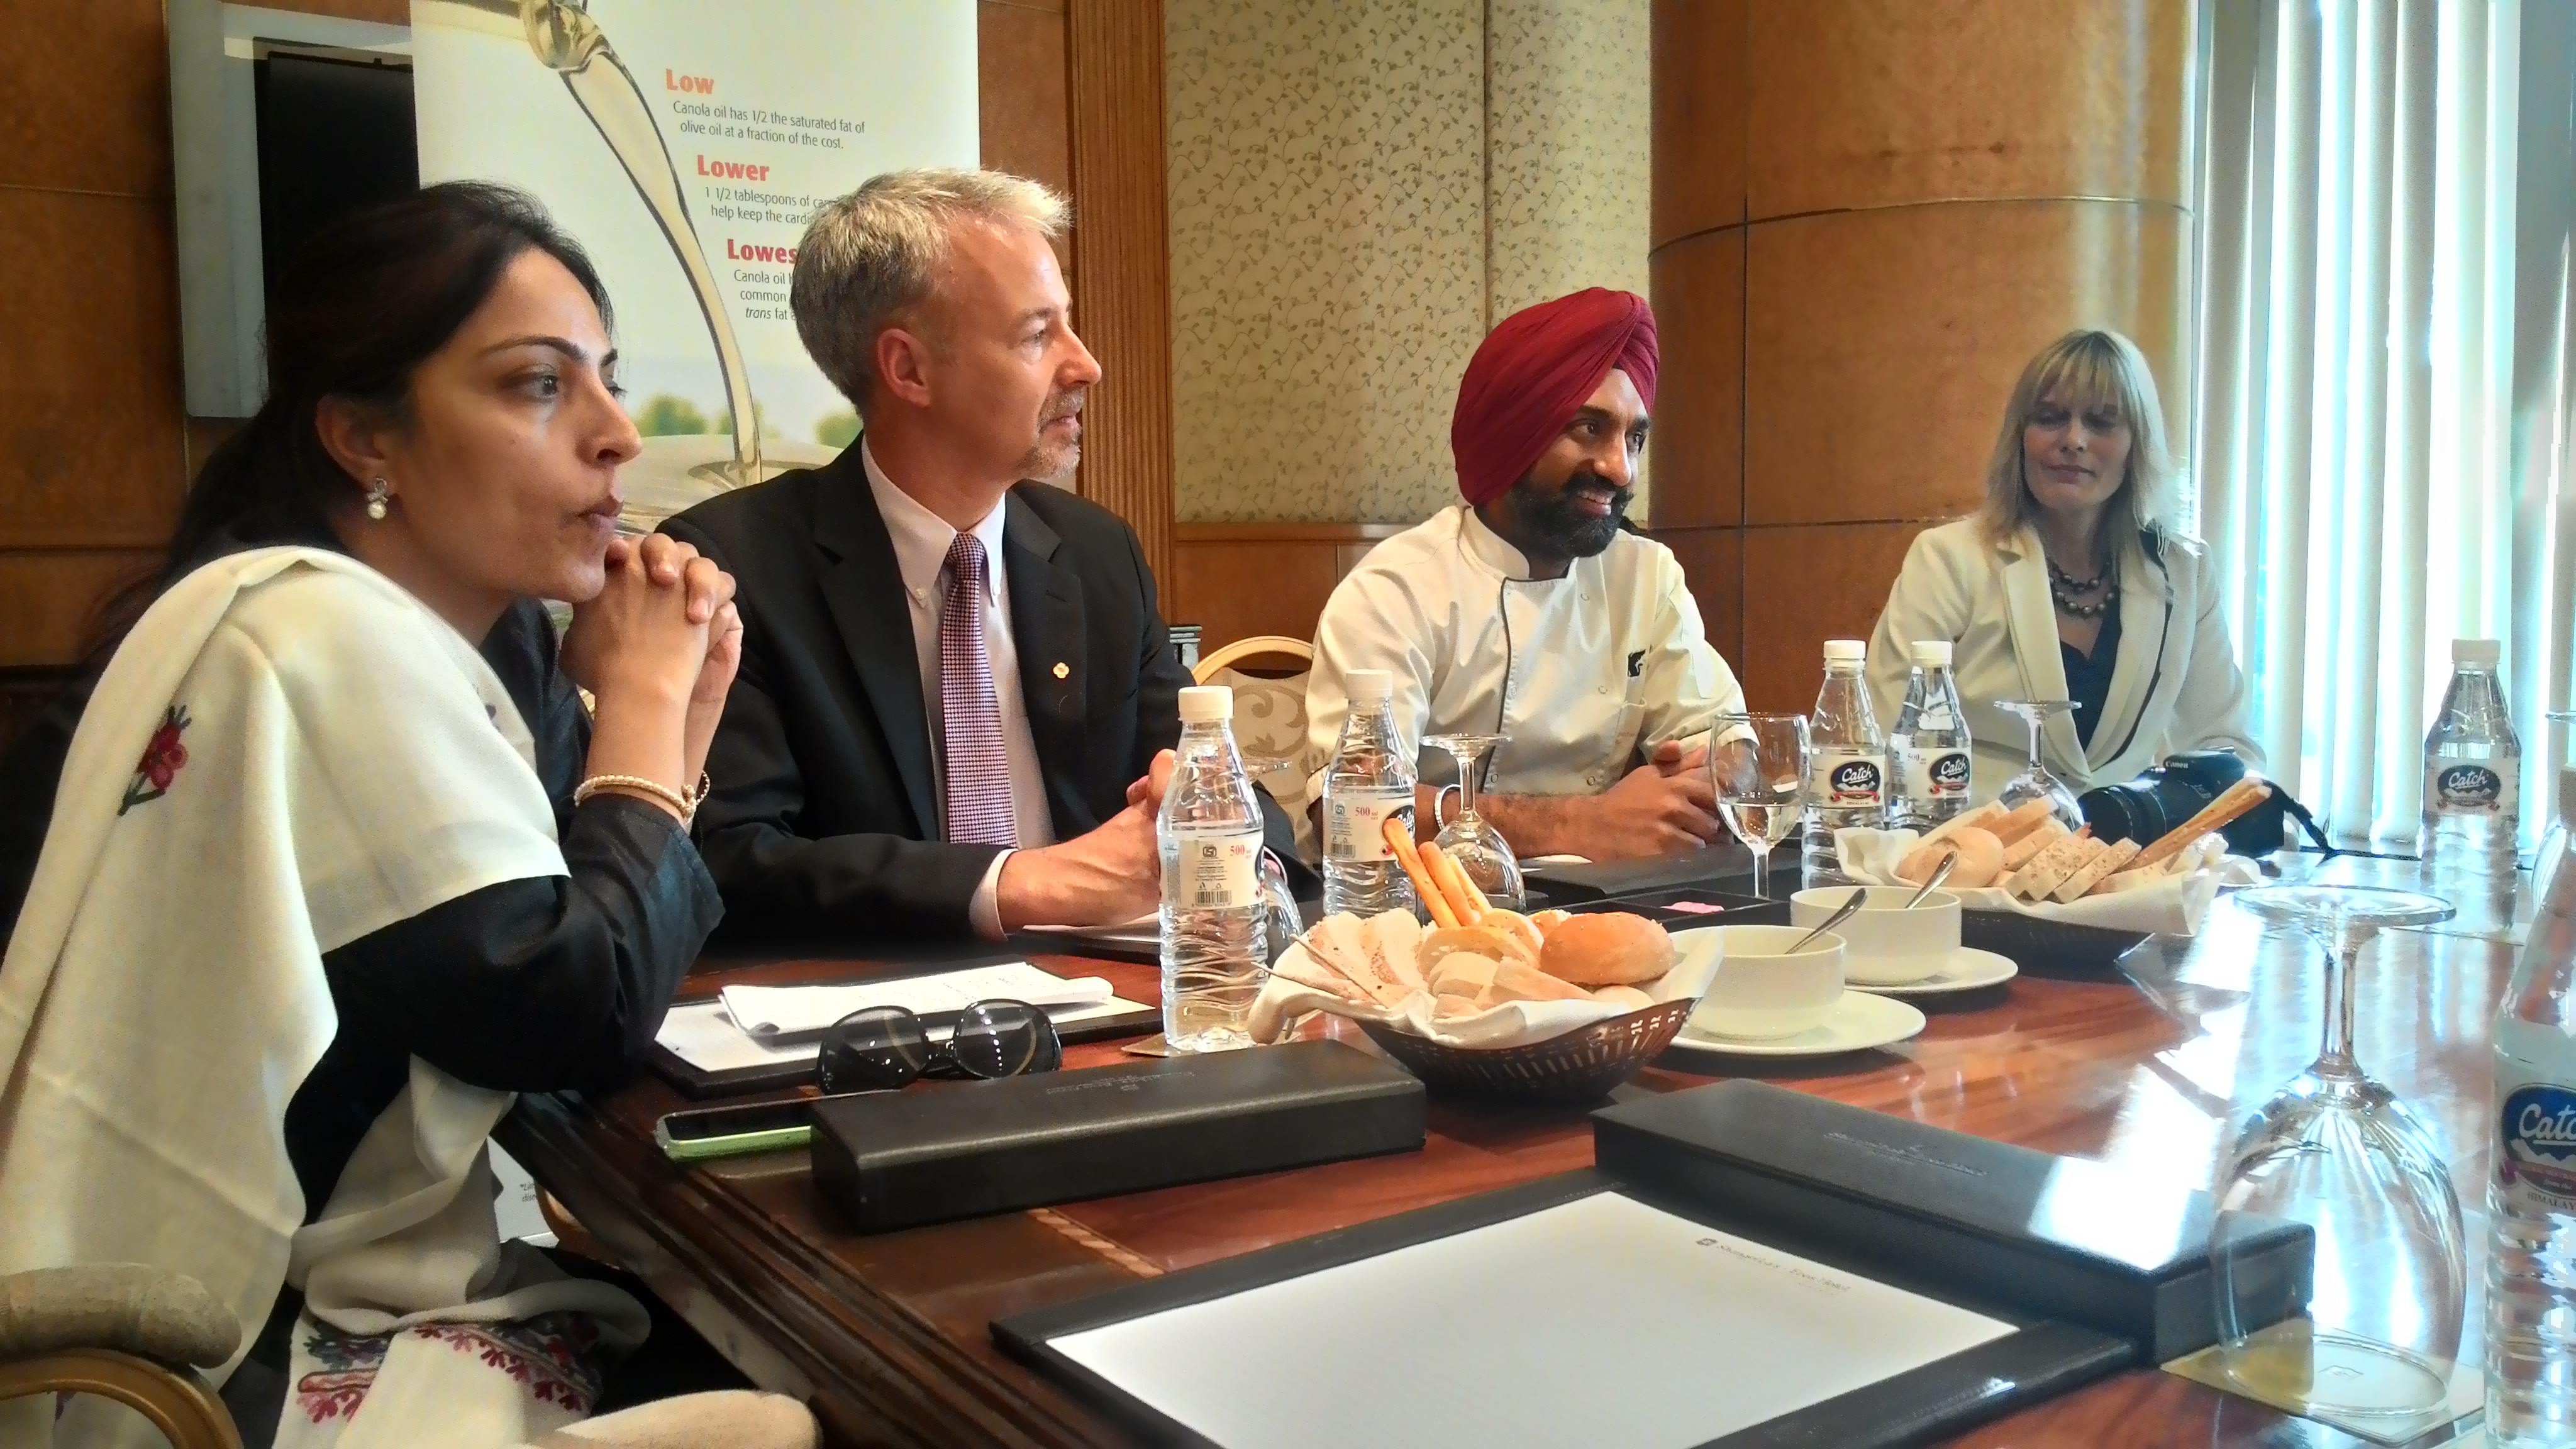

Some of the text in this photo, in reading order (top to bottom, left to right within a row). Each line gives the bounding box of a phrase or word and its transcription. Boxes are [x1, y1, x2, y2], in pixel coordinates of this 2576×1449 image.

[666, 69, 714, 94] Low
[673, 101, 865, 134] Canola oil has 1/2 the saturated fat of
[680, 120, 845, 149] olive oil at a fraction of the cost.
[697, 154, 770, 182] Lower
[705, 186, 709, 198] 1
[715, 187, 731, 201] 1/2
[735, 189, 797, 206] tablespoons
[800, 194, 809, 207] of
[711, 204, 735, 221] help
[738, 208, 763, 224] keep
[765, 209, 782, 222] the
[726, 238, 798, 265] Lowes
[734, 269, 770, 283] Canola
[773, 272, 786, 285] oil
[740, 291, 787, 303] common
[745, 307, 772, 319] trans
[775, 307, 788, 320] fat
[1841, 764, 1873, 783] Catch
[1940, 757, 1967, 776] Catch
[2165, 760, 2189, 769] Canon
[2448, 769, 2489, 789] Catch
[1355, 806, 1370, 816] 500
[1230, 844, 1245, 856] 500
[2519, 1103, 2576, 1140] Catc
